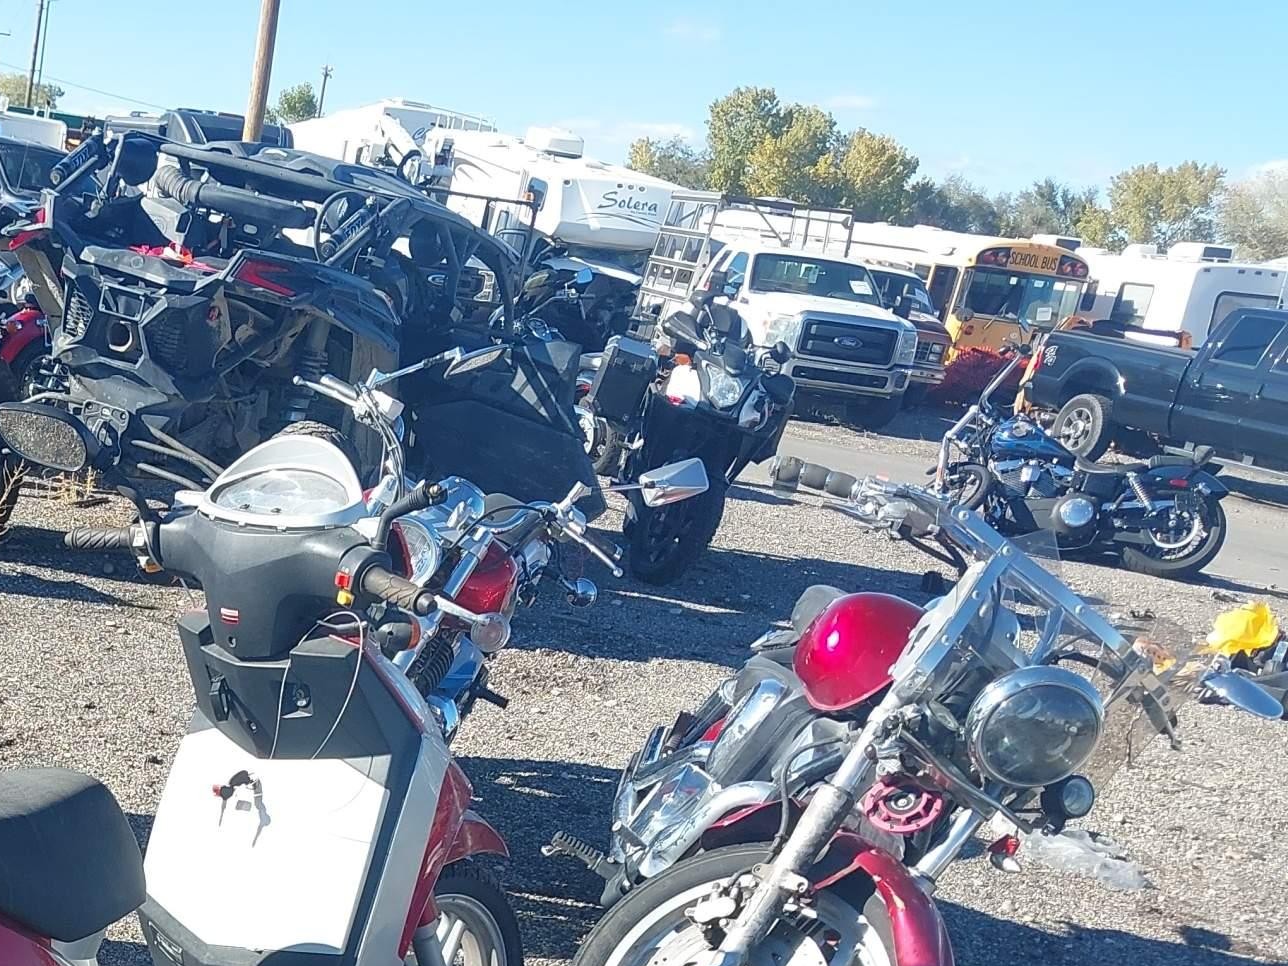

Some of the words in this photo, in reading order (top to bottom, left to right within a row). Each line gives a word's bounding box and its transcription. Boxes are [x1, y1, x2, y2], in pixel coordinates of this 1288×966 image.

[597, 191, 658, 213] Solera
[1009, 251, 1039, 269] SCHOOL
[1041, 257, 1058, 271] BUS
